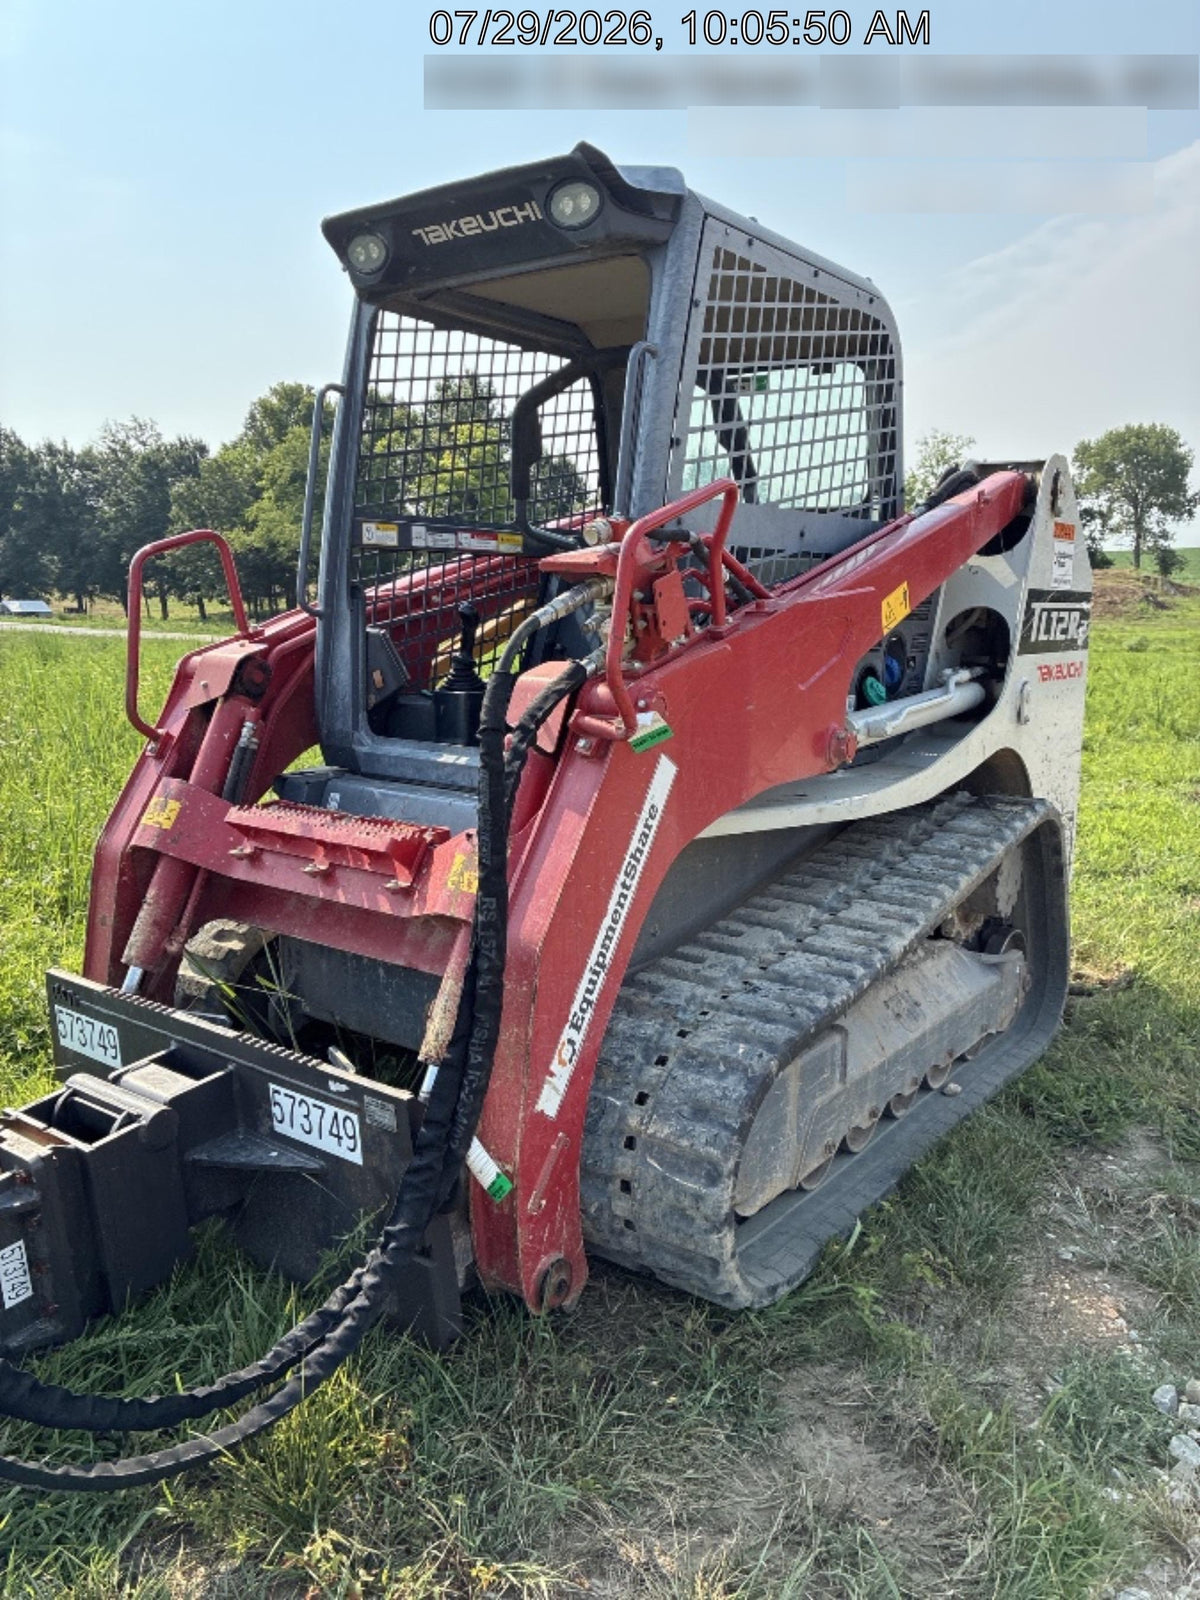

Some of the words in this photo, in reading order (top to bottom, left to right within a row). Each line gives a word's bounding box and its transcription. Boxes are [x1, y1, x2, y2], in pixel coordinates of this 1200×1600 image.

[568, 803, 660, 1037] EquipmentShare
[55, 1008, 119, 1061] 573749
[270, 1089, 360, 1152] 573749
[1, 1245, 30, 1301] 573749
